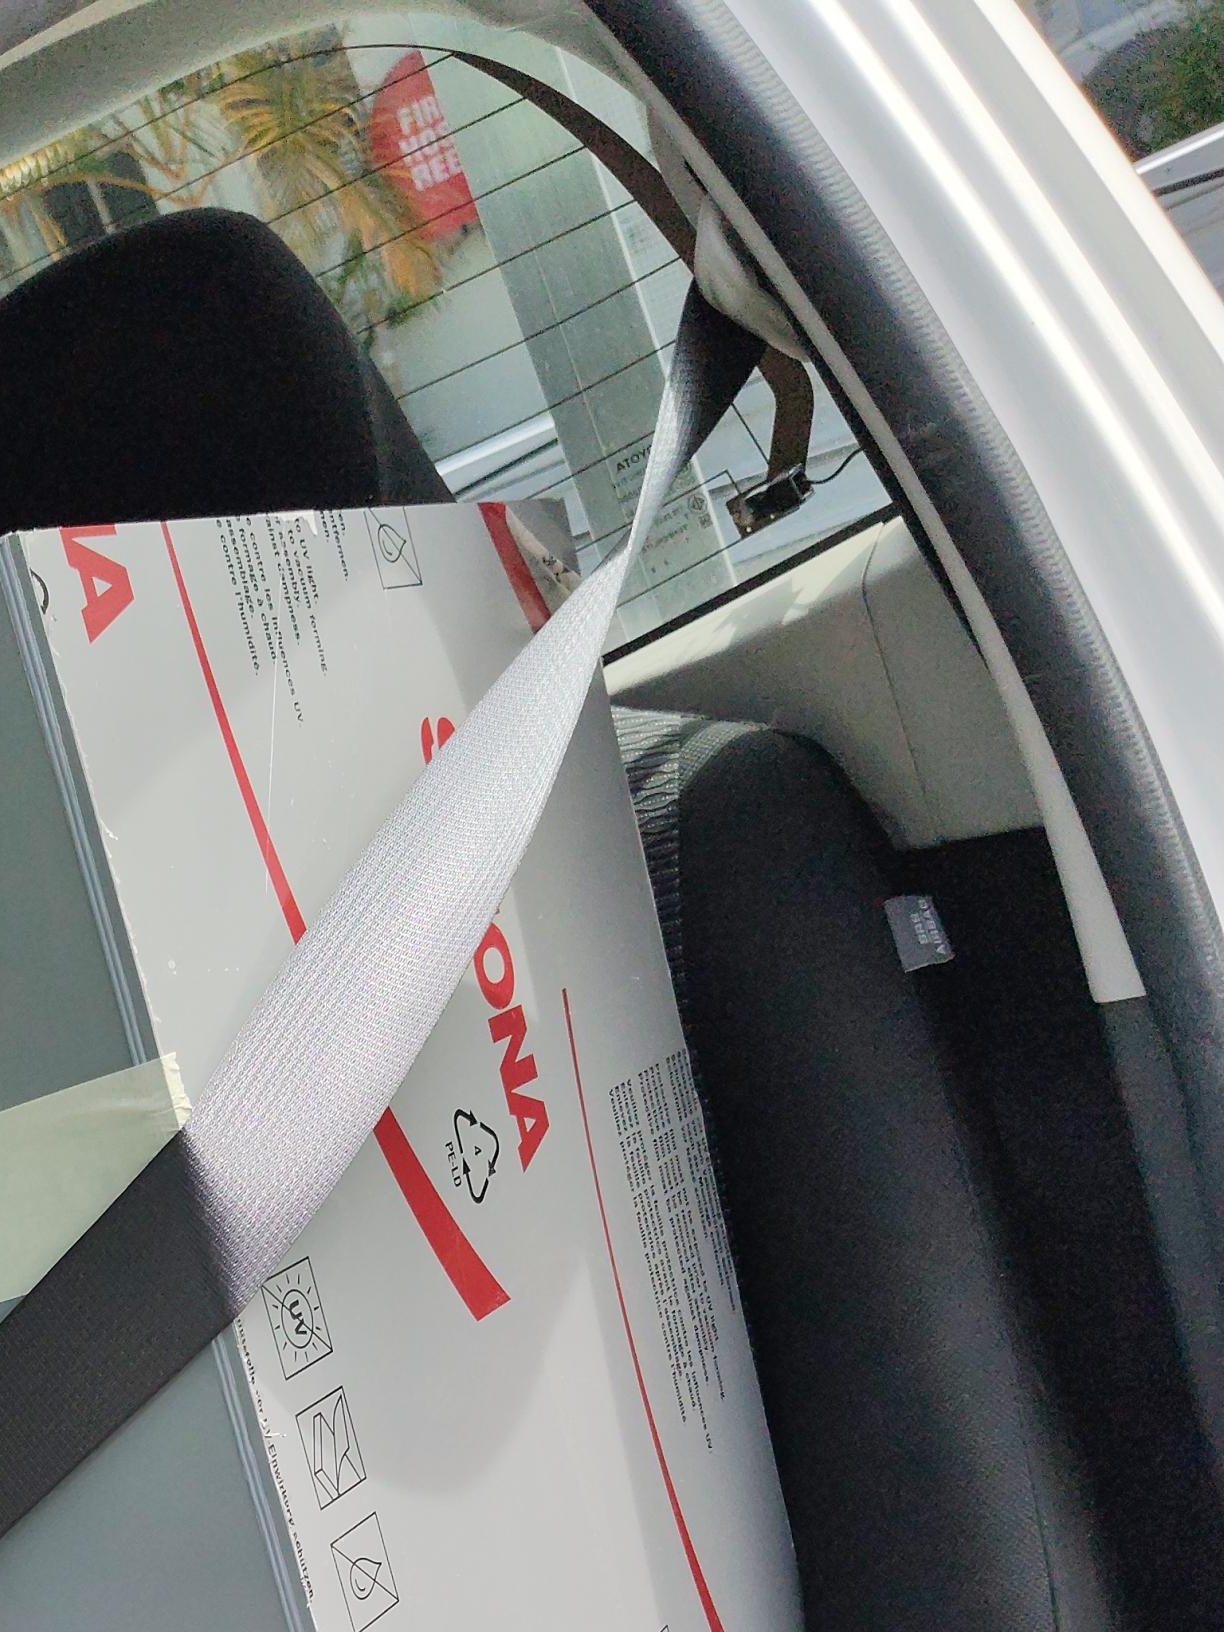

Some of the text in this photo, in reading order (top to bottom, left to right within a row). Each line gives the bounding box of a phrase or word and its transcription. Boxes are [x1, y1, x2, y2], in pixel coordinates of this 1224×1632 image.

[218, 532, 261, 677] contre l'humidité.
[237, 526, 259, 593] formage
[255, 596, 265, 608] à
[286, 527, 328, 677] to vacuum forming.
[292, 515, 320, 605] to UV light.
[248, 530, 267, 583] contre
[262, 586, 274, 612] les
[292, 700, 304, 728] UV.
[444, 1140, 463, 1188] PE-LD
[288, 1299, 308, 1335] UV
